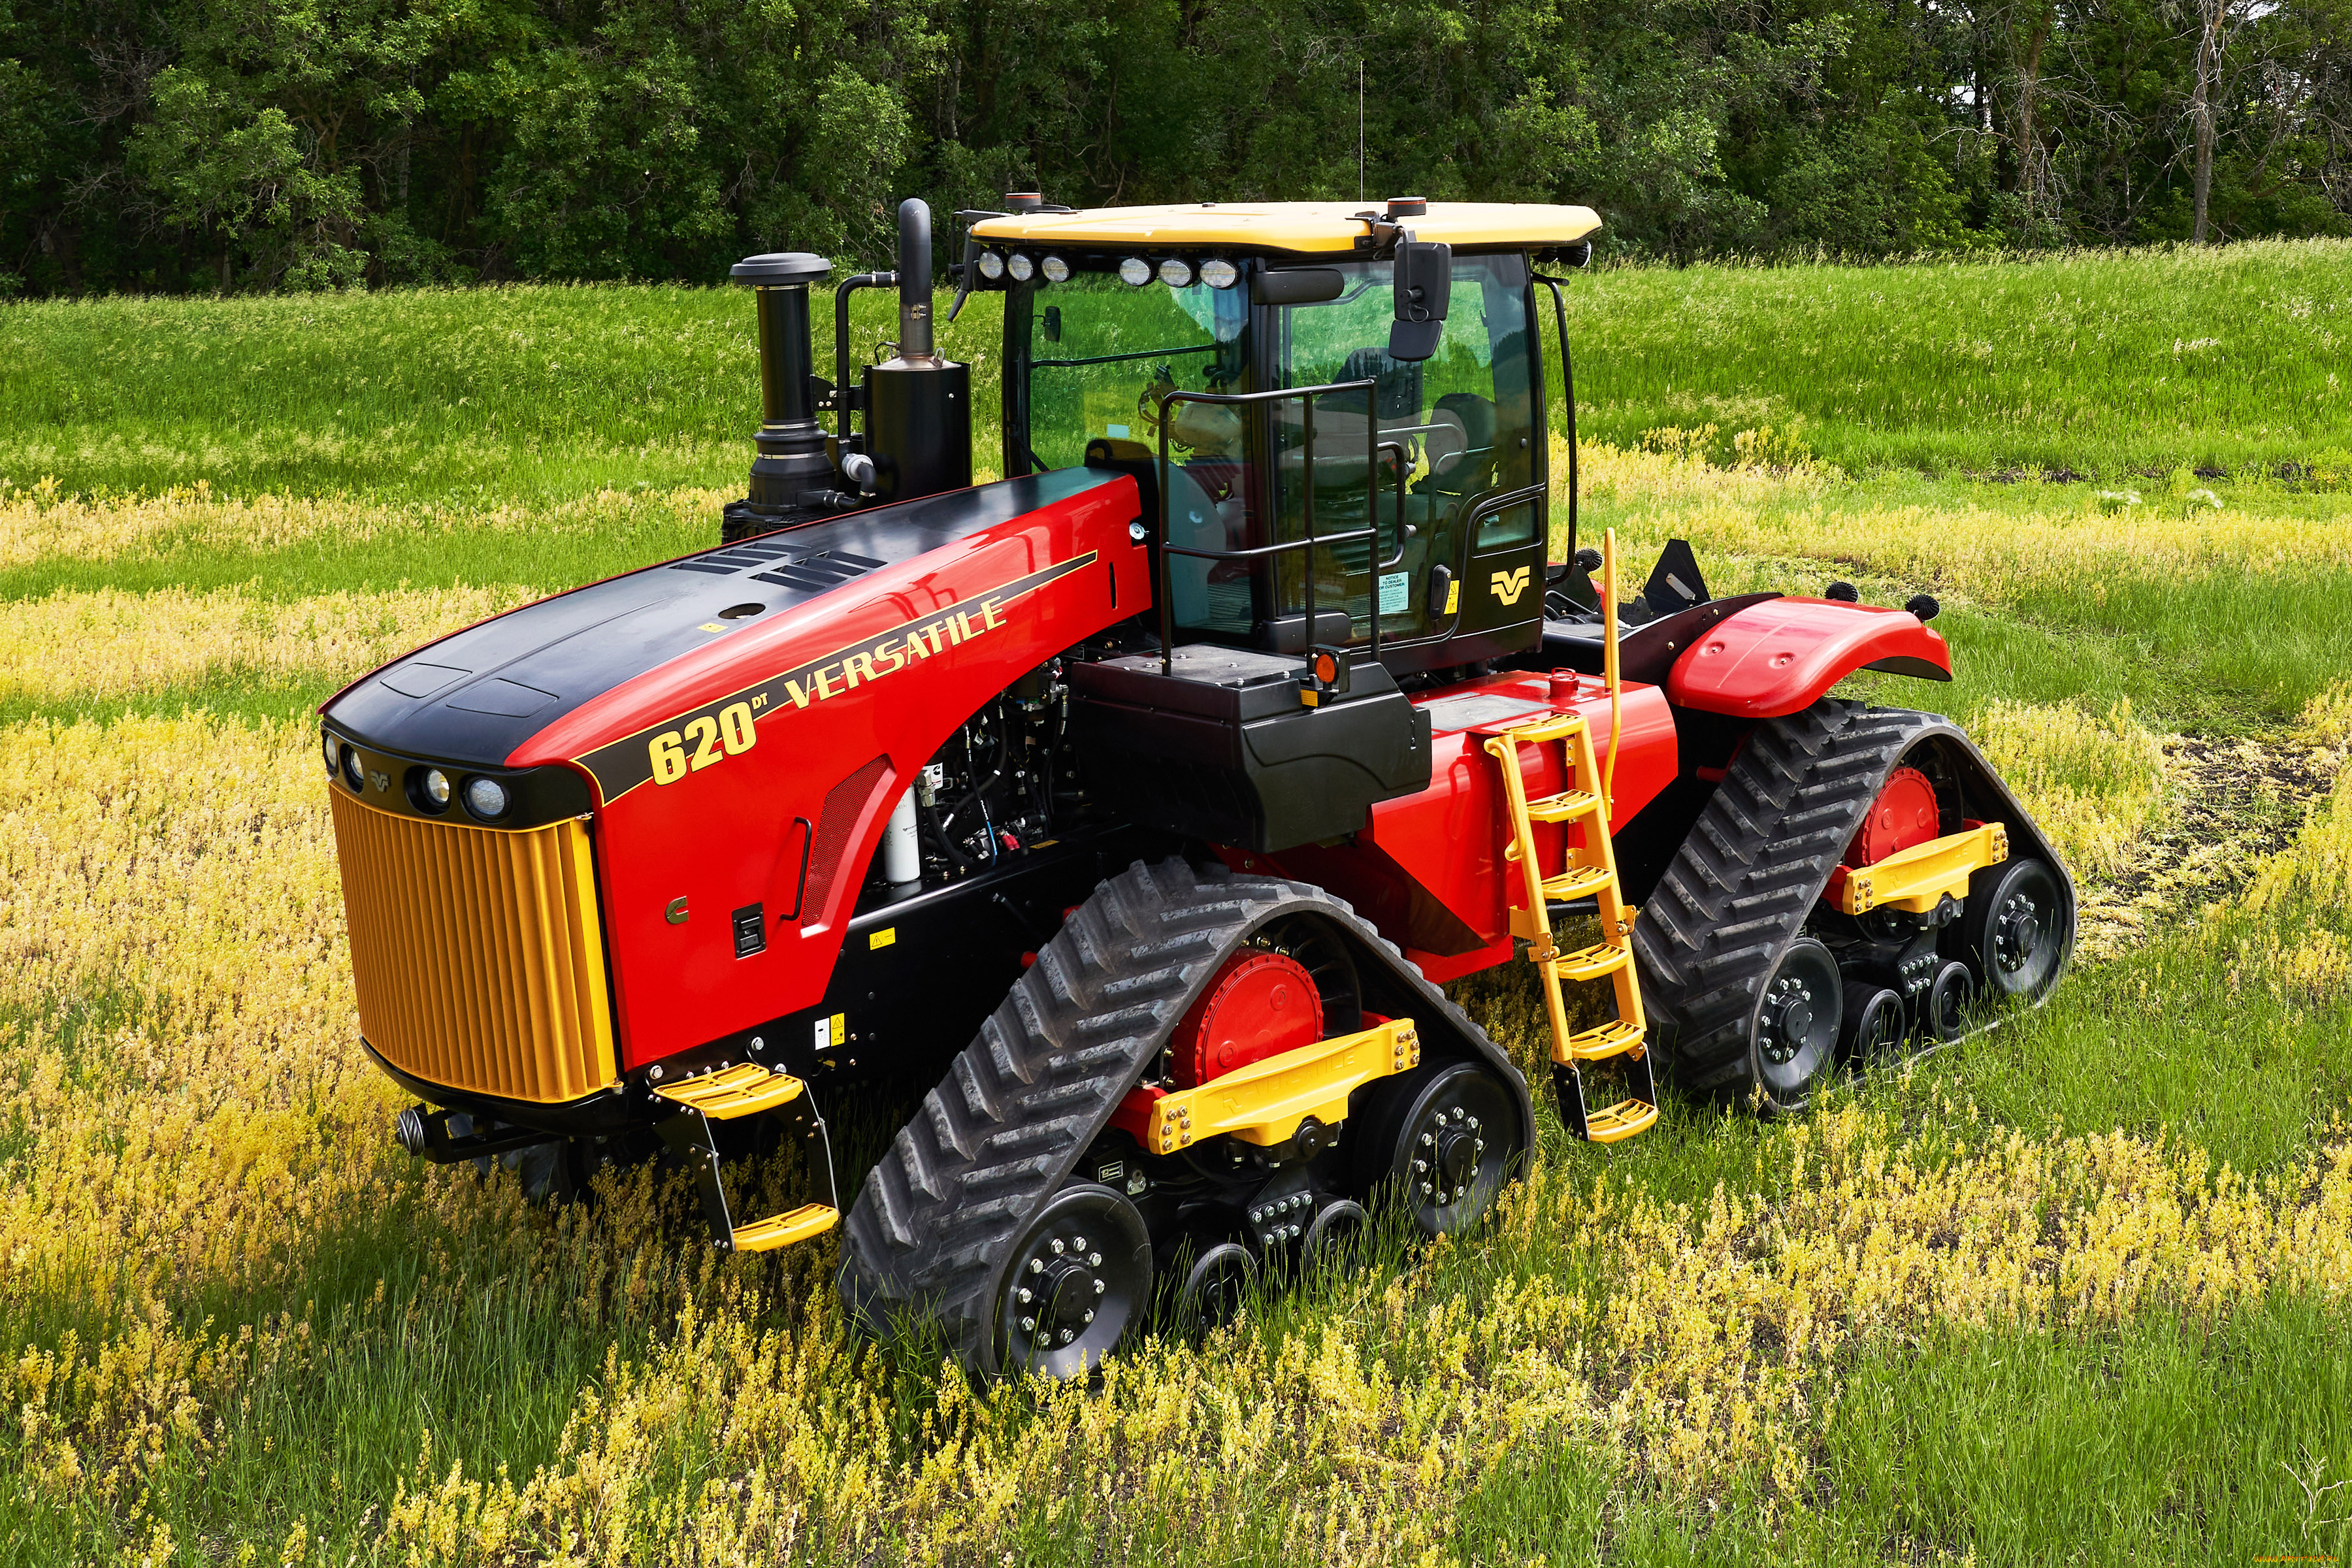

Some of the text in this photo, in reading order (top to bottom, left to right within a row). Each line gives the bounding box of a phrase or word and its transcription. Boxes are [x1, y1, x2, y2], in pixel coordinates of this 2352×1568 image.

[648, 595, 1007, 785] 620 DT VERSATILE
